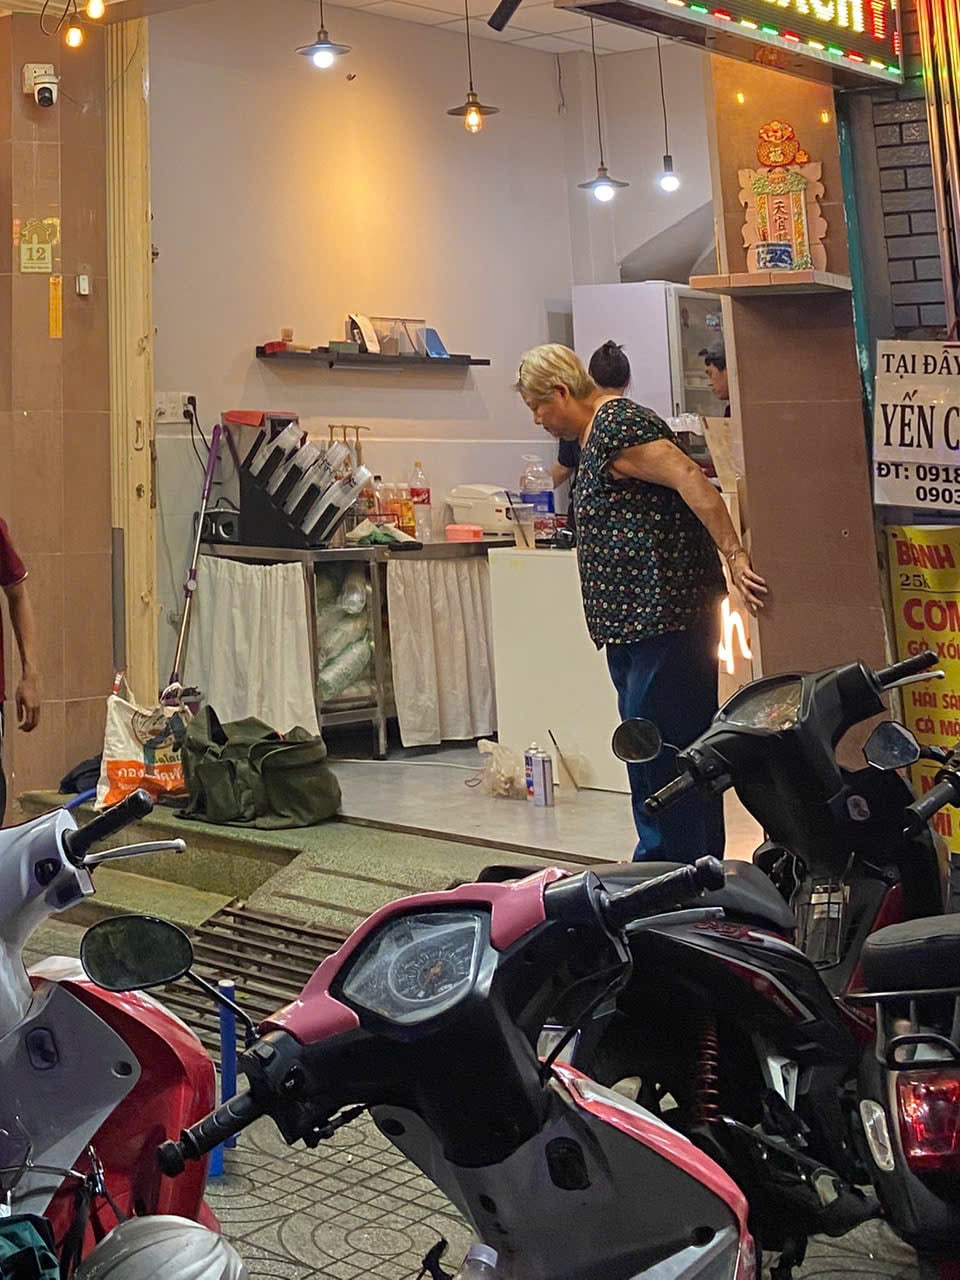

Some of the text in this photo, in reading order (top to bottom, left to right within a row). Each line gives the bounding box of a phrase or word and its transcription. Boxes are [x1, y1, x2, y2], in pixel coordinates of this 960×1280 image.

[25, 247, 46, 261] 12
[882, 354, 917, 379] TẠI
[880, 389, 935, 449] YẾN
[877, 462, 909, 480] ĐT:
